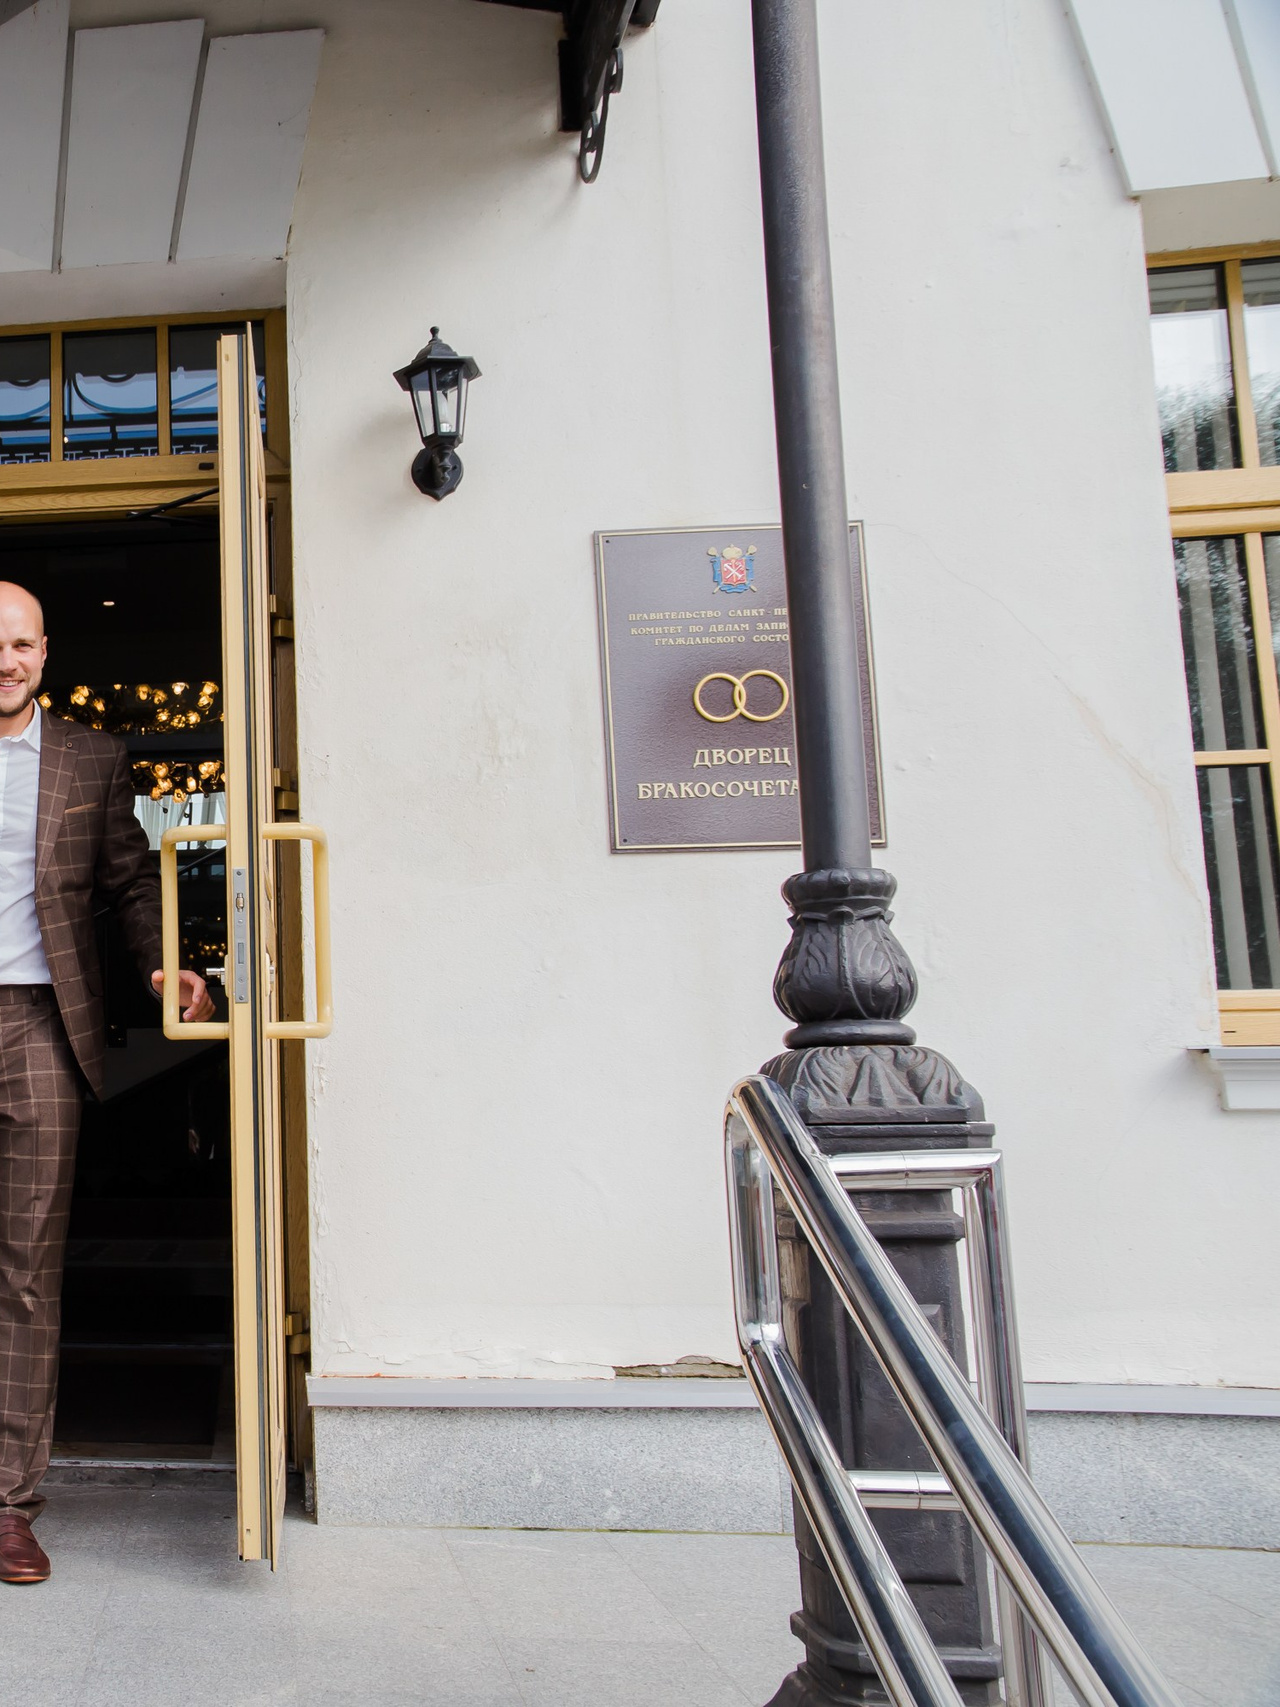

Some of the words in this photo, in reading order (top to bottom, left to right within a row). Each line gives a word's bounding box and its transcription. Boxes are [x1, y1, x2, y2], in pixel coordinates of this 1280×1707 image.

[629, 610, 721, 621] ПРАВИТЕЛЬСТВО
[631, 626, 682, 635] КОМИТЕТ
[689, 625, 703, 633] ПО
[709, 623, 749, 633] ДЕЛАМ
[756, 622, 790, 631] ЗАПИ
[655, 635, 745, 646] ГРАЖДАНСКОГО
[752, 634, 790, 643] СОСТО
[693, 747, 790, 769] ДВОРЕЦ
[637, 780, 799, 800] БРАКОСОЧЕТА
